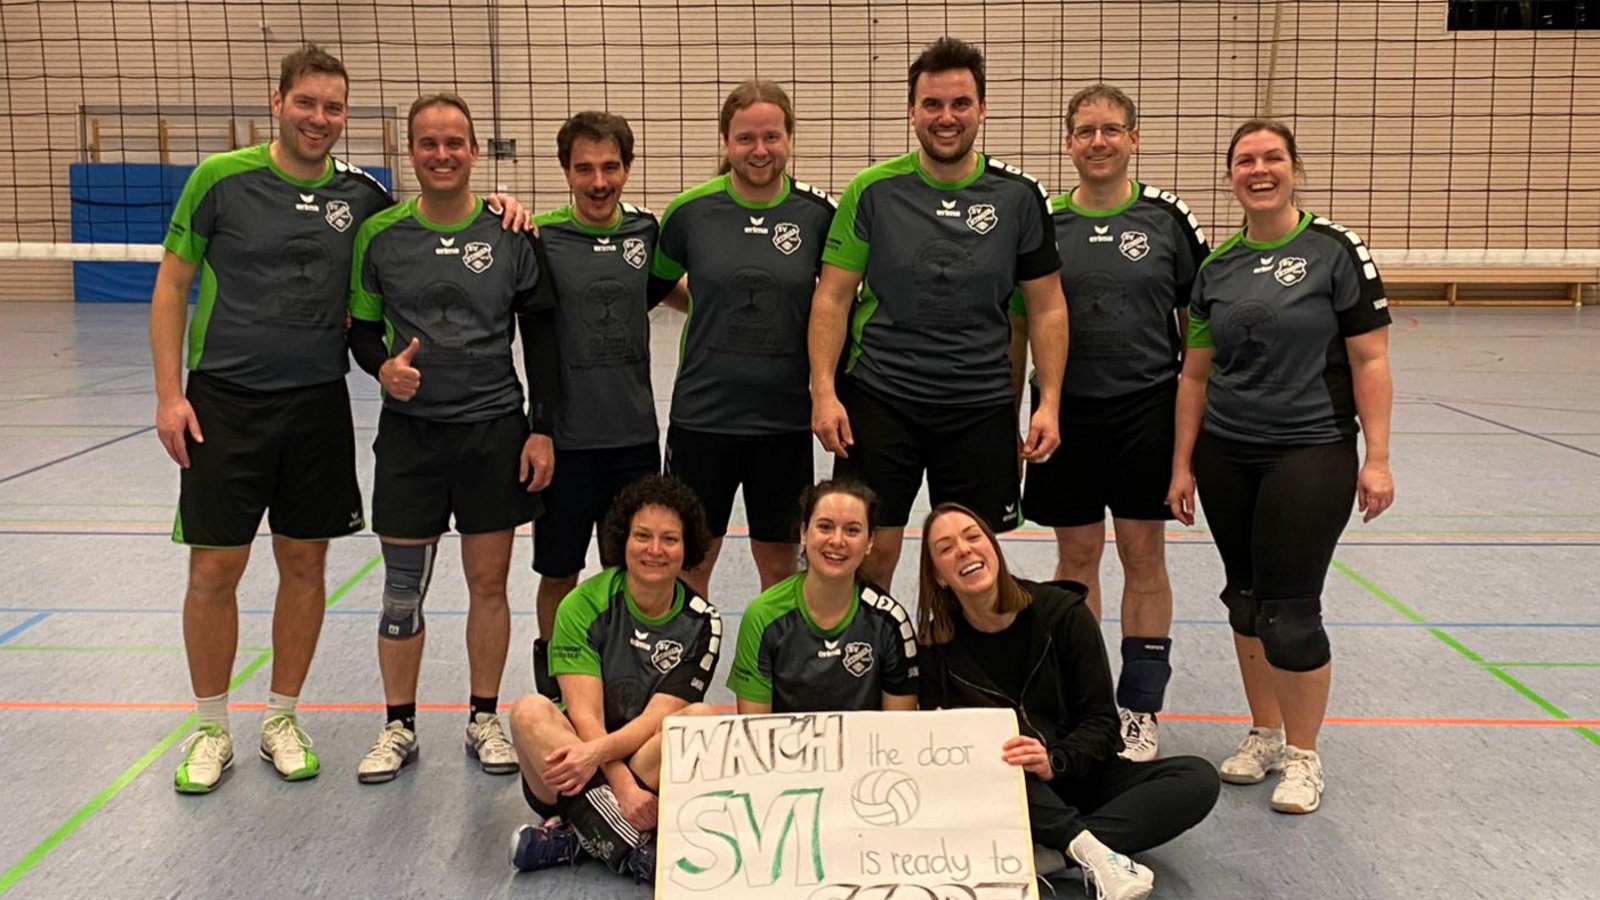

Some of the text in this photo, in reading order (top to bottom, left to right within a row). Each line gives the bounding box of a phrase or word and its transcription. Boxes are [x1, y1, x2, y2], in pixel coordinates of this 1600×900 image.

[744, 226, 768, 234] erima
[668, 714, 975, 784] WATCH the door
[668, 787, 825, 891] SVI
[859, 834, 882, 875] is
[891, 838, 970, 882] ready
[989, 840, 1023, 874] to
